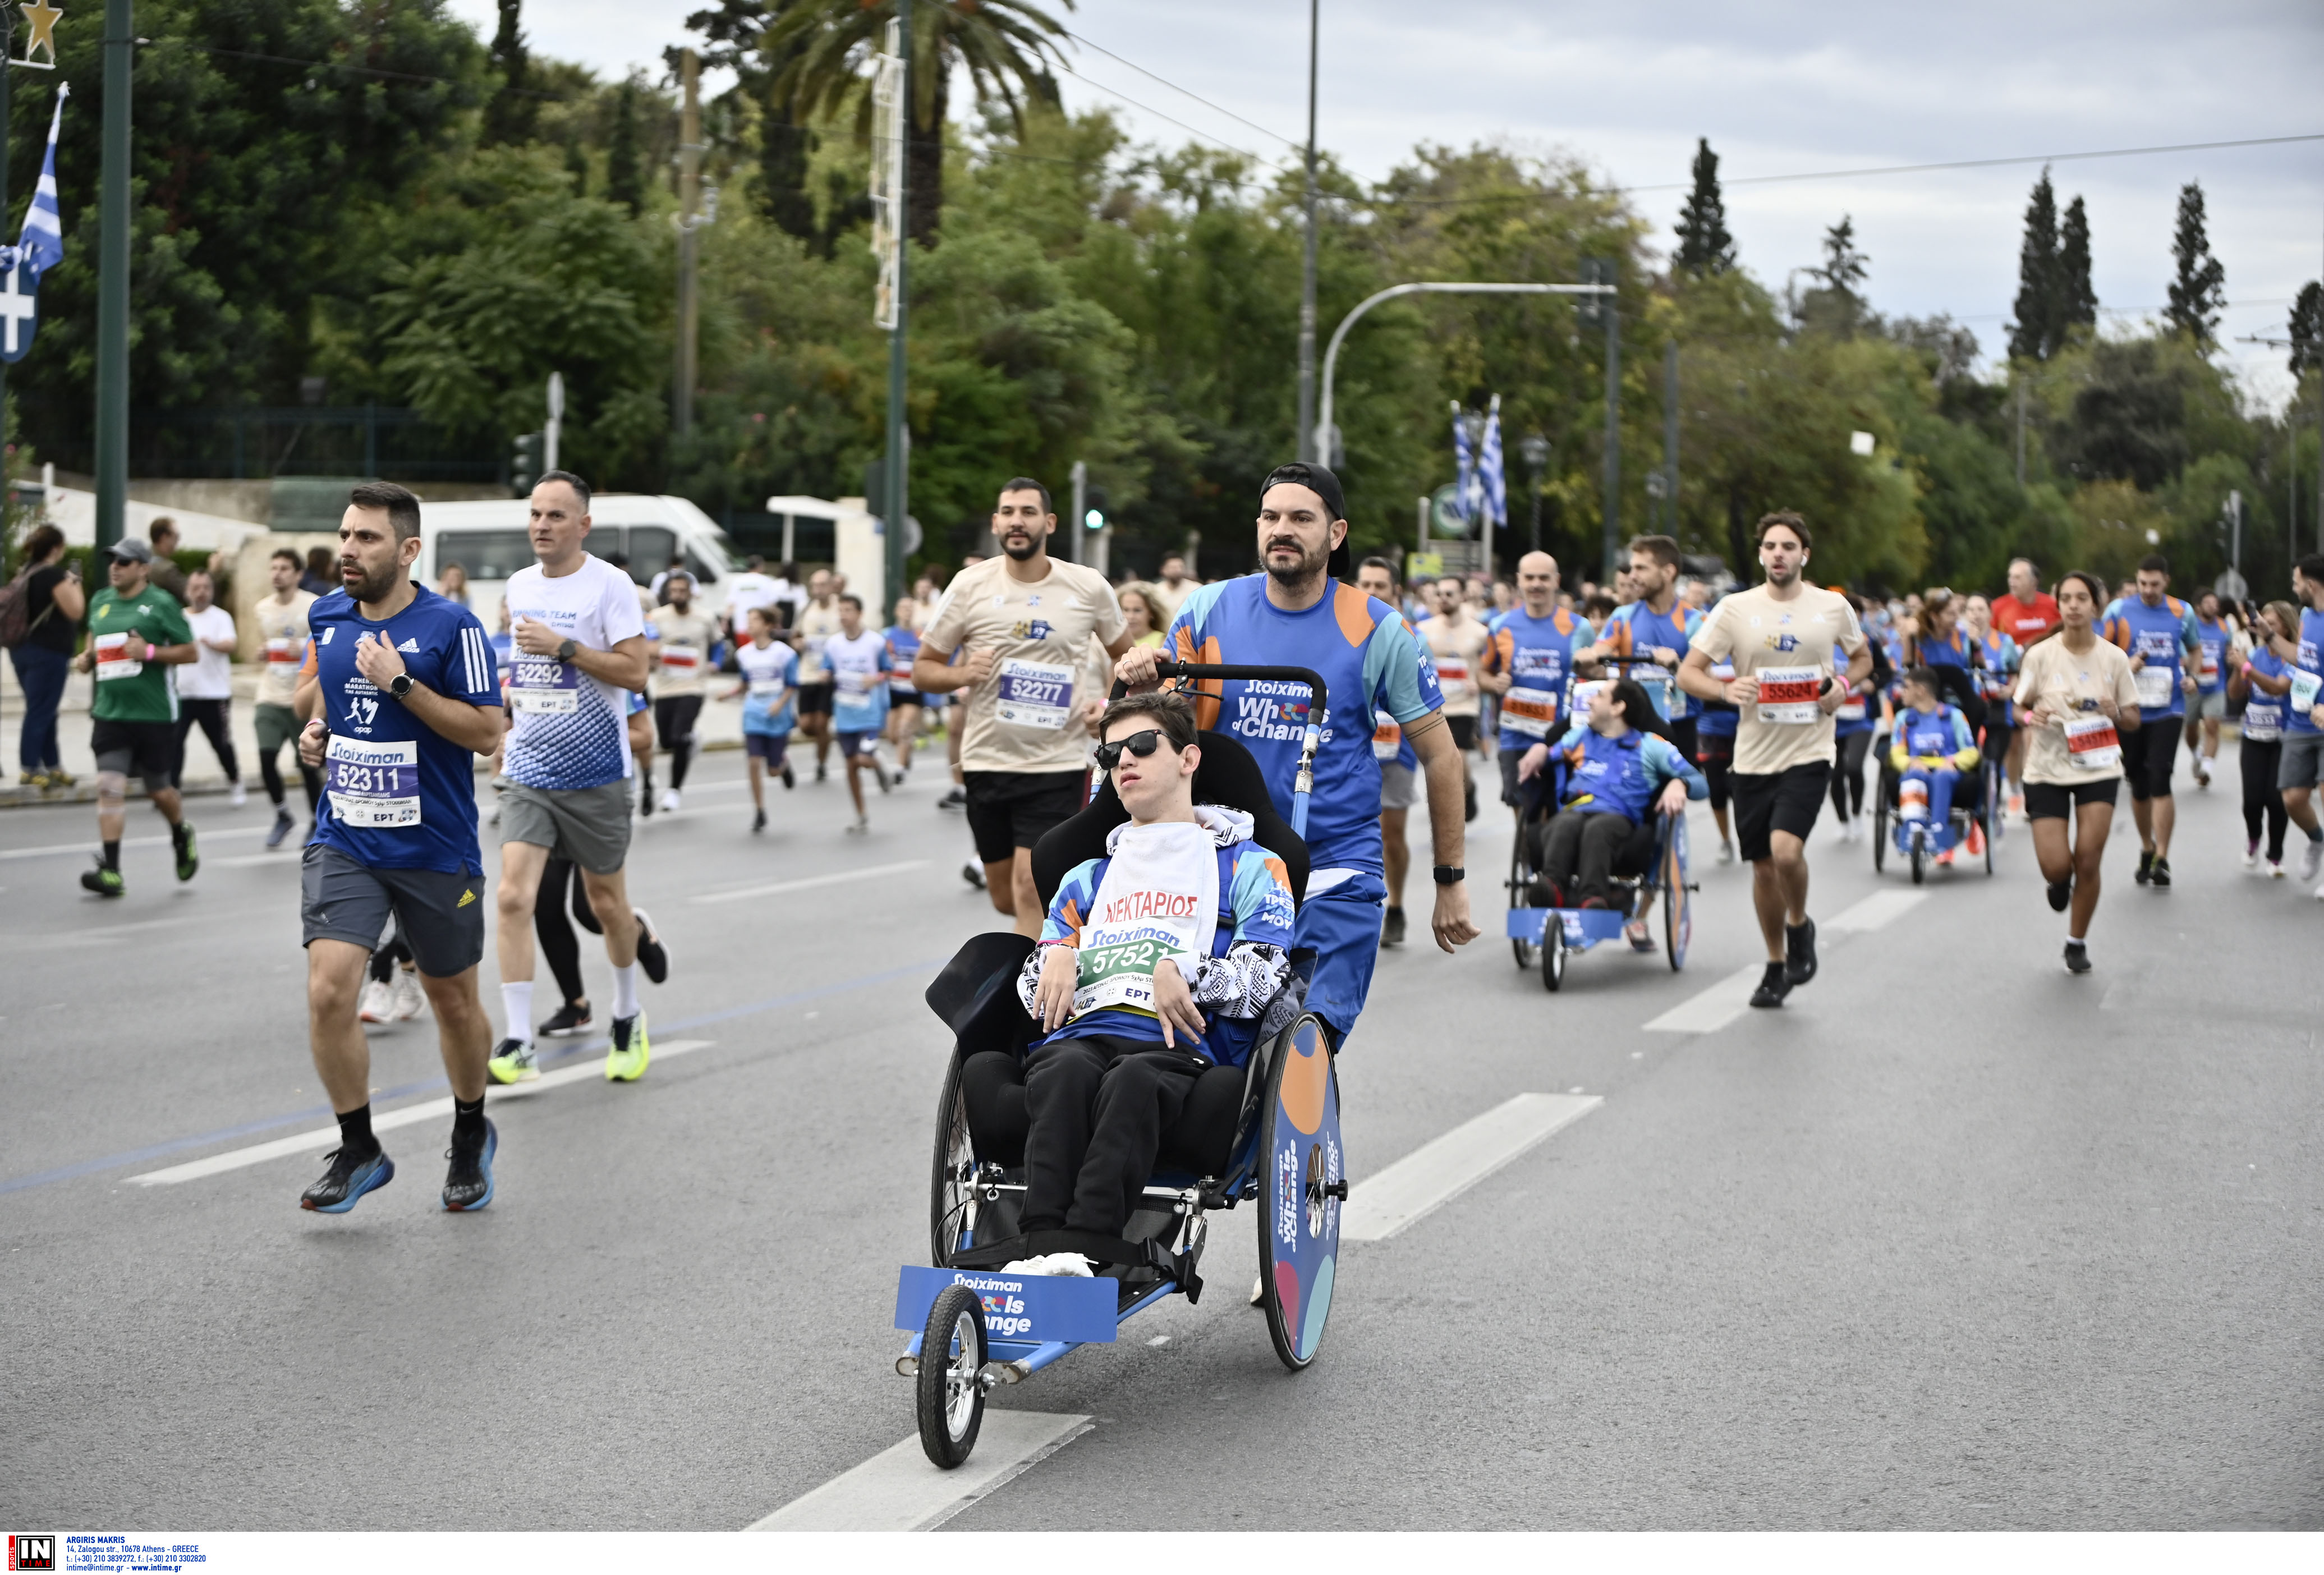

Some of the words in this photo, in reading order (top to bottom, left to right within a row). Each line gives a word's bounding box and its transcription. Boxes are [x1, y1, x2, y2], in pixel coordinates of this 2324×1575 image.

[550, 611, 577, 620] TEAM
[516, 664, 563, 683] 52292
[1008, 663, 1067, 681] Stoiximan
[1011, 678, 1063, 701] 52277
[1769, 683, 1812, 699] 55624
[354, 727, 372, 735] opap
[1232, 720, 1242, 731] of
[1241, 716, 1333, 742] Chane
[332, 742, 405, 764] Stoiximan
[337, 763, 399, 792] 52311
[374, 813, 394, 821] ΕΡΤ
[456, 895, 476, 908] adidas
[1103, 891, 1197, 924] ΝΕΚΤΑΡΙΟΣ
[1261, 911, 1293, 930] ΜΟΥ
[1087, 927, 1181, 948] Stoiximan
[1125, 988, 1151, 1001] ΕΡΤ
[951, 1273, 1022, 1293] Stoiximan
